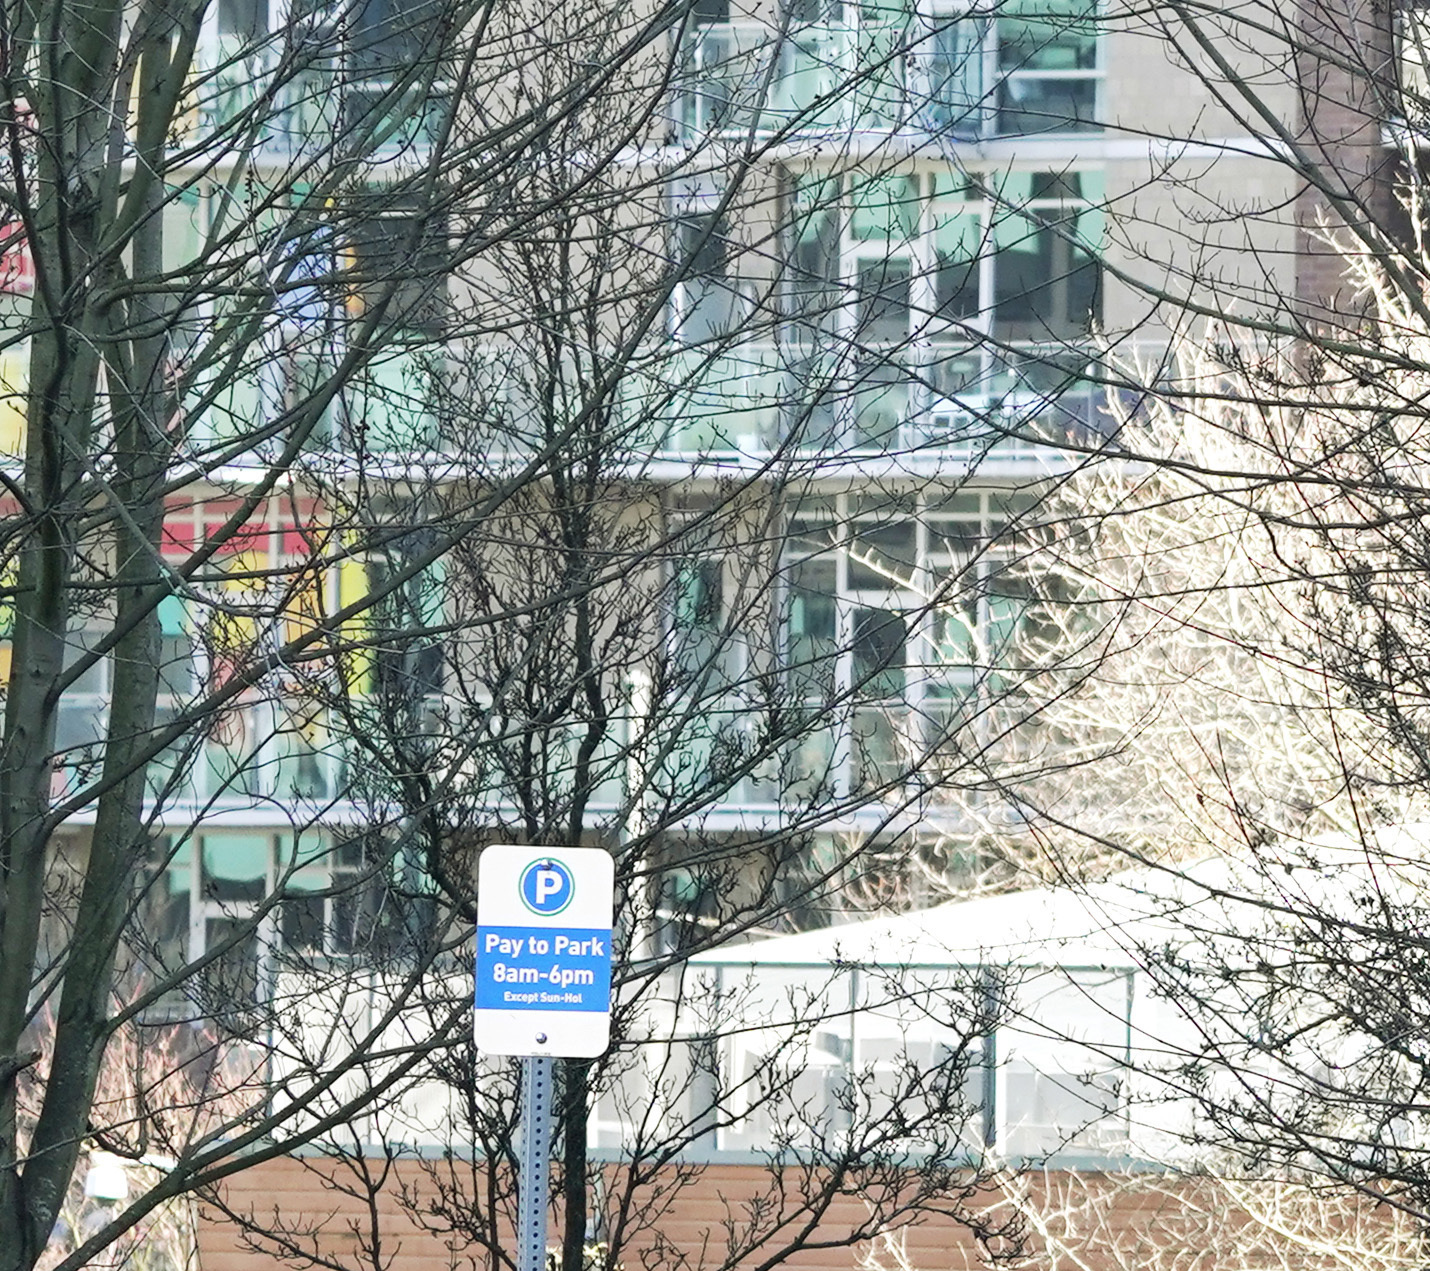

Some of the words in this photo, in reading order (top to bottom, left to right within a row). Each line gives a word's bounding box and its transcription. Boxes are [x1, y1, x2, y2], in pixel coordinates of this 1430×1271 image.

[535, 870, 563, 905] P
[485, 934, 524, 958] Pay
[529, 936, 549, 955] to
[554, 936, 605, 956] Park
[493, 962, 594, 988] 8am-6pm
[503, 991, 540, 1005] Except
[540, 991, 583, 1005] Sun-Hol
